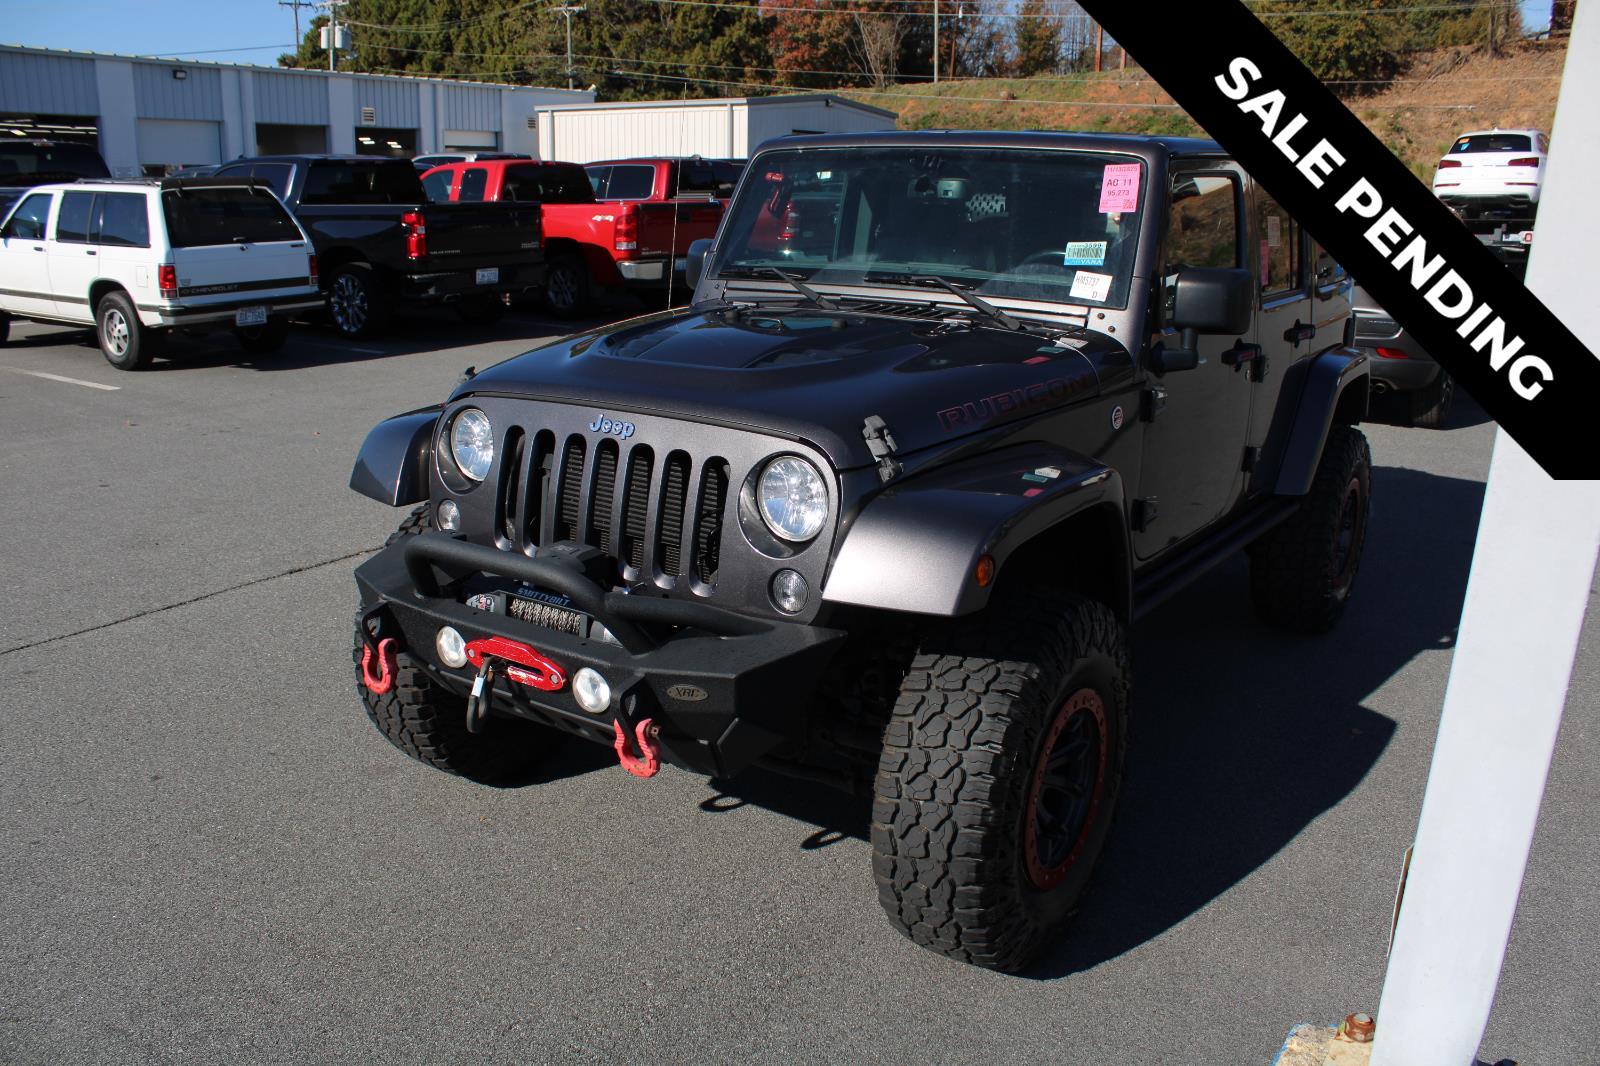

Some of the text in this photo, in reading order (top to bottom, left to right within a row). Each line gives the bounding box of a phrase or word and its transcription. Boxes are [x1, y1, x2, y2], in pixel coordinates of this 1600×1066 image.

[936, 372, 1090, 433] RUBICON
[589, 413, 635, 440] Jeep
[518, 587, 571, 606] SMITTYBILT
